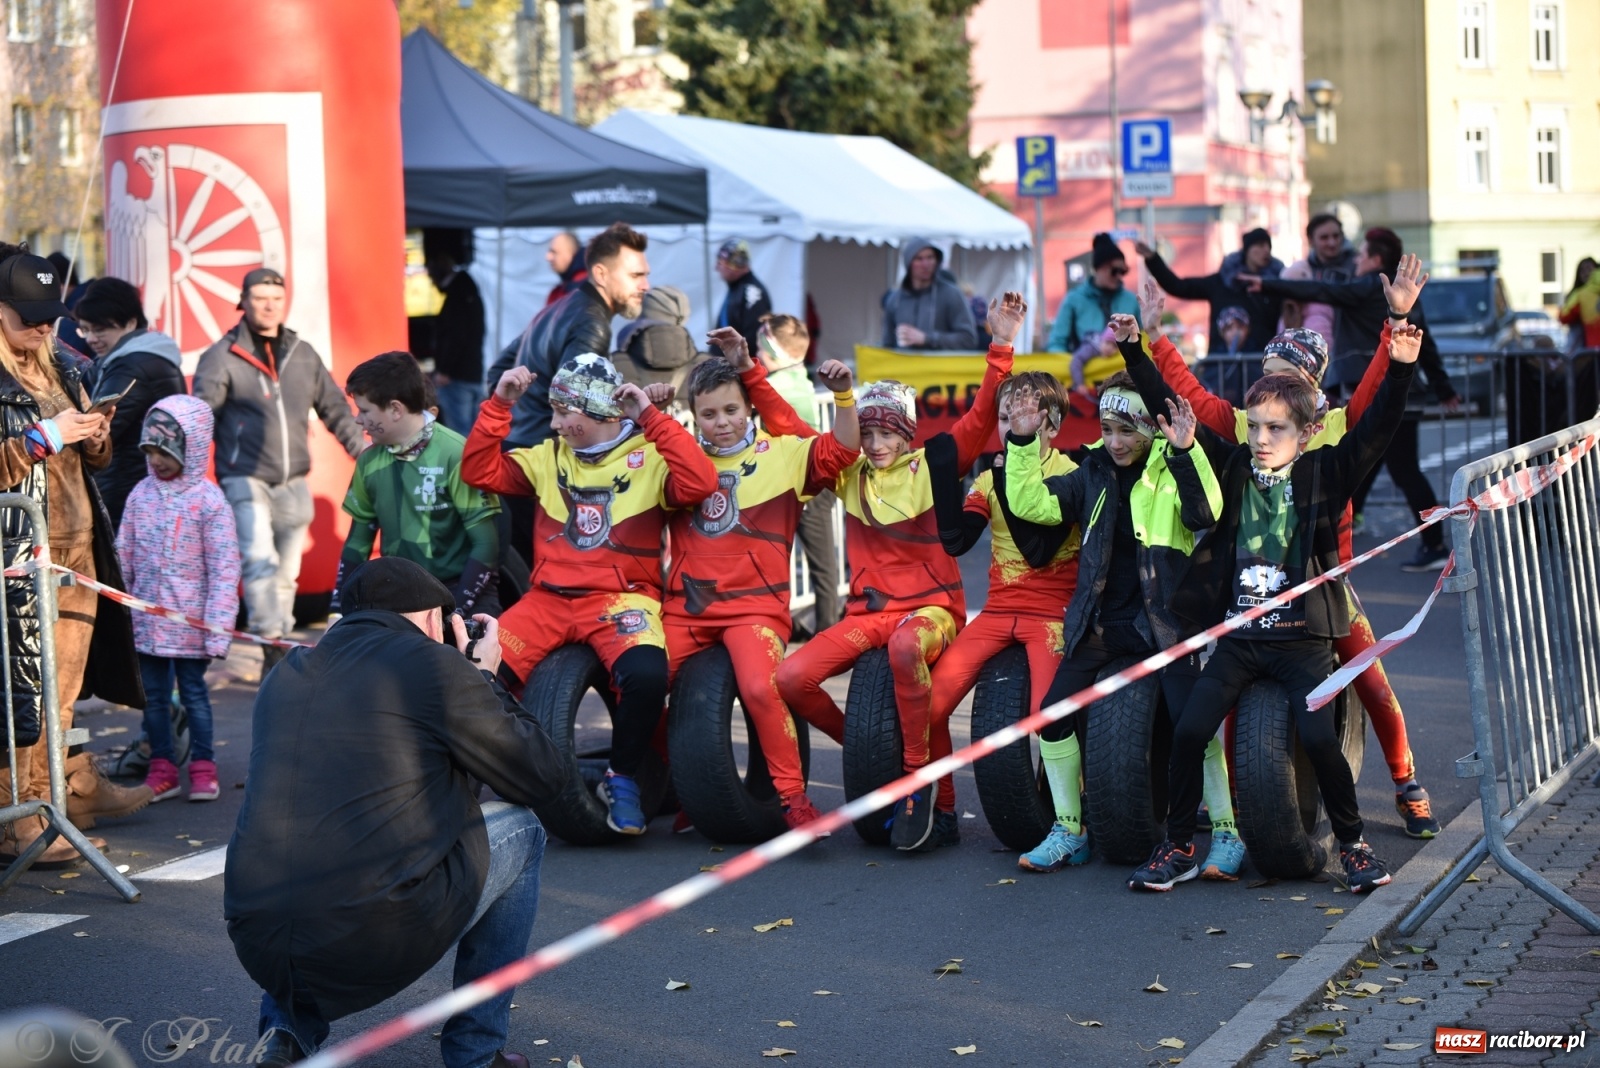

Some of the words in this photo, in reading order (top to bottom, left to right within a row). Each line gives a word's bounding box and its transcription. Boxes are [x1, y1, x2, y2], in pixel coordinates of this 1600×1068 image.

[1025, 138, 1048, 165] P
[1130, 123, 1163, 169] P
[568, 424, 585, 437] 28
[704, 521, 720, 532] OCR
[577, 536, 593, 547] OCR
